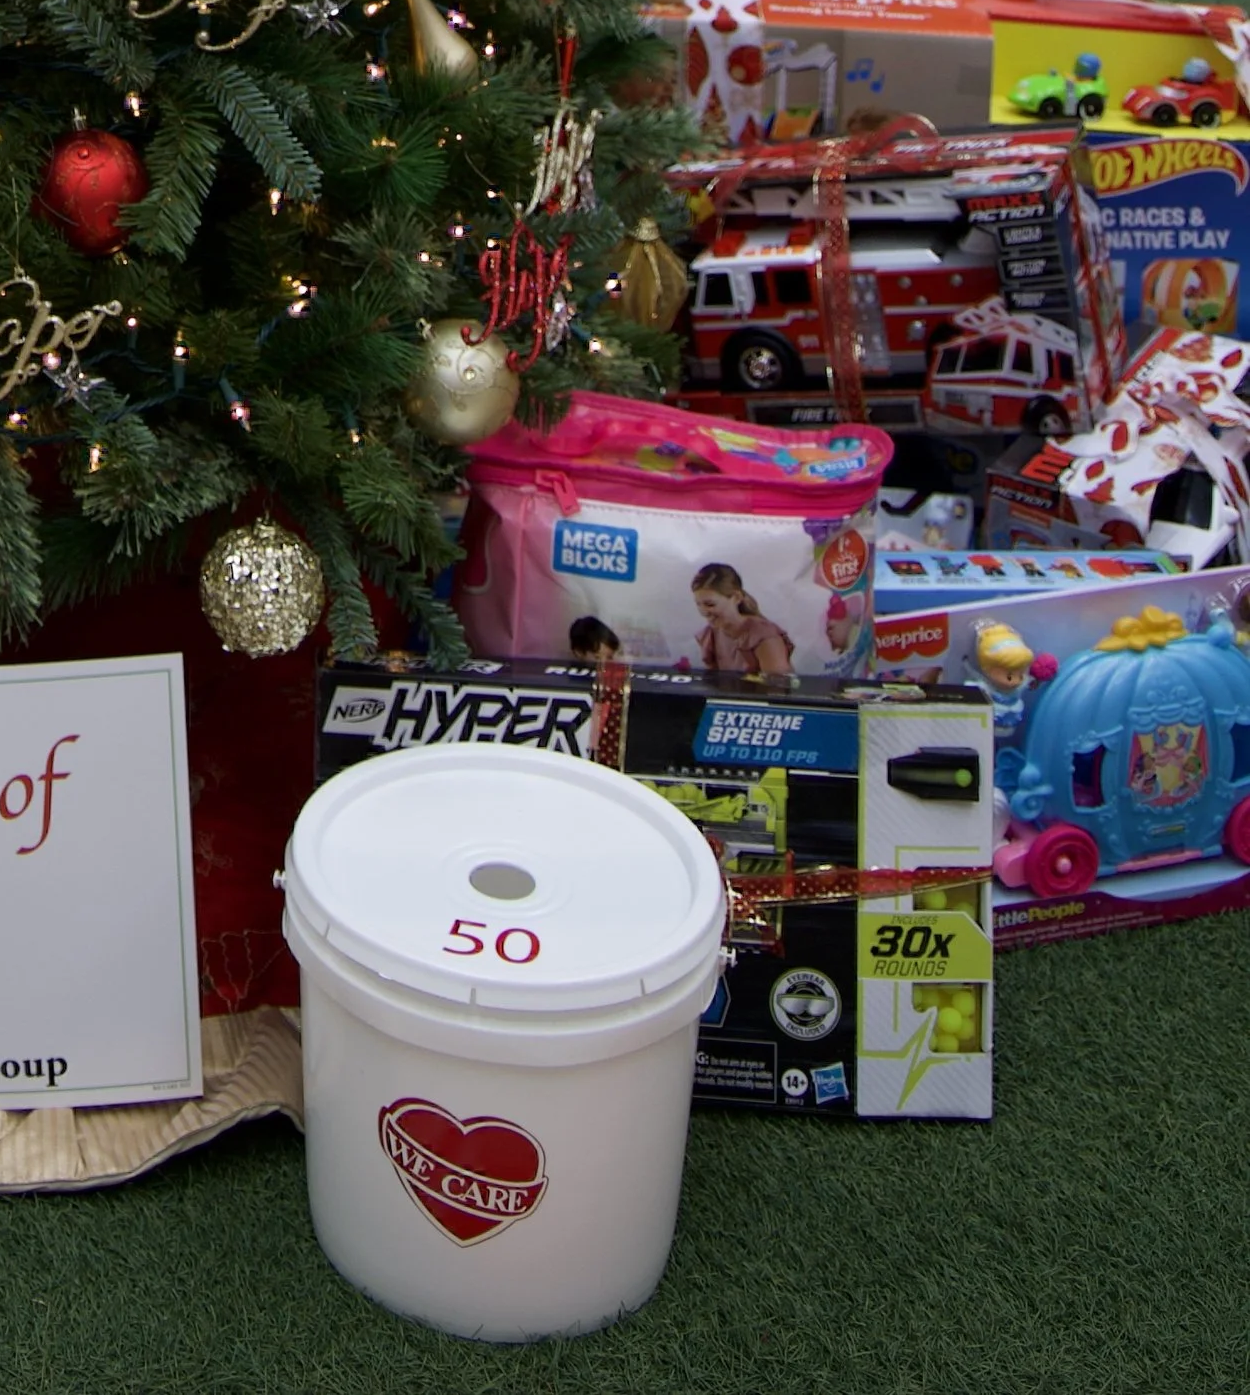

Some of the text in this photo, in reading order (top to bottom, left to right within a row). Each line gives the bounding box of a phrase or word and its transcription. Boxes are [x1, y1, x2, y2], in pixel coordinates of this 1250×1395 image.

[967, 203, 1046, 224] ACTION
[1119, 206, 1187, 228] RACES
[1188, 206, 1207, 227] &
[1104, 229, 1231, 250] NATIVE PLAY
[562, 528, 628, 555] MEGA
[561, 547, 629, 574] BLOKS
[381, 685, 594, 759] HYPER
[712, 710, 805, 731] EXTREME
[706, 726, 783, 747] SPEED
[702, 744, 820, 764] UP TO 110 FPS
[442, 918, 541, 965] 50
[873, 959, 948, 977] ROUNDS
[785, 1076, 806, 1089] 14+
[387, 1128, 529, 1214] WE CARE
